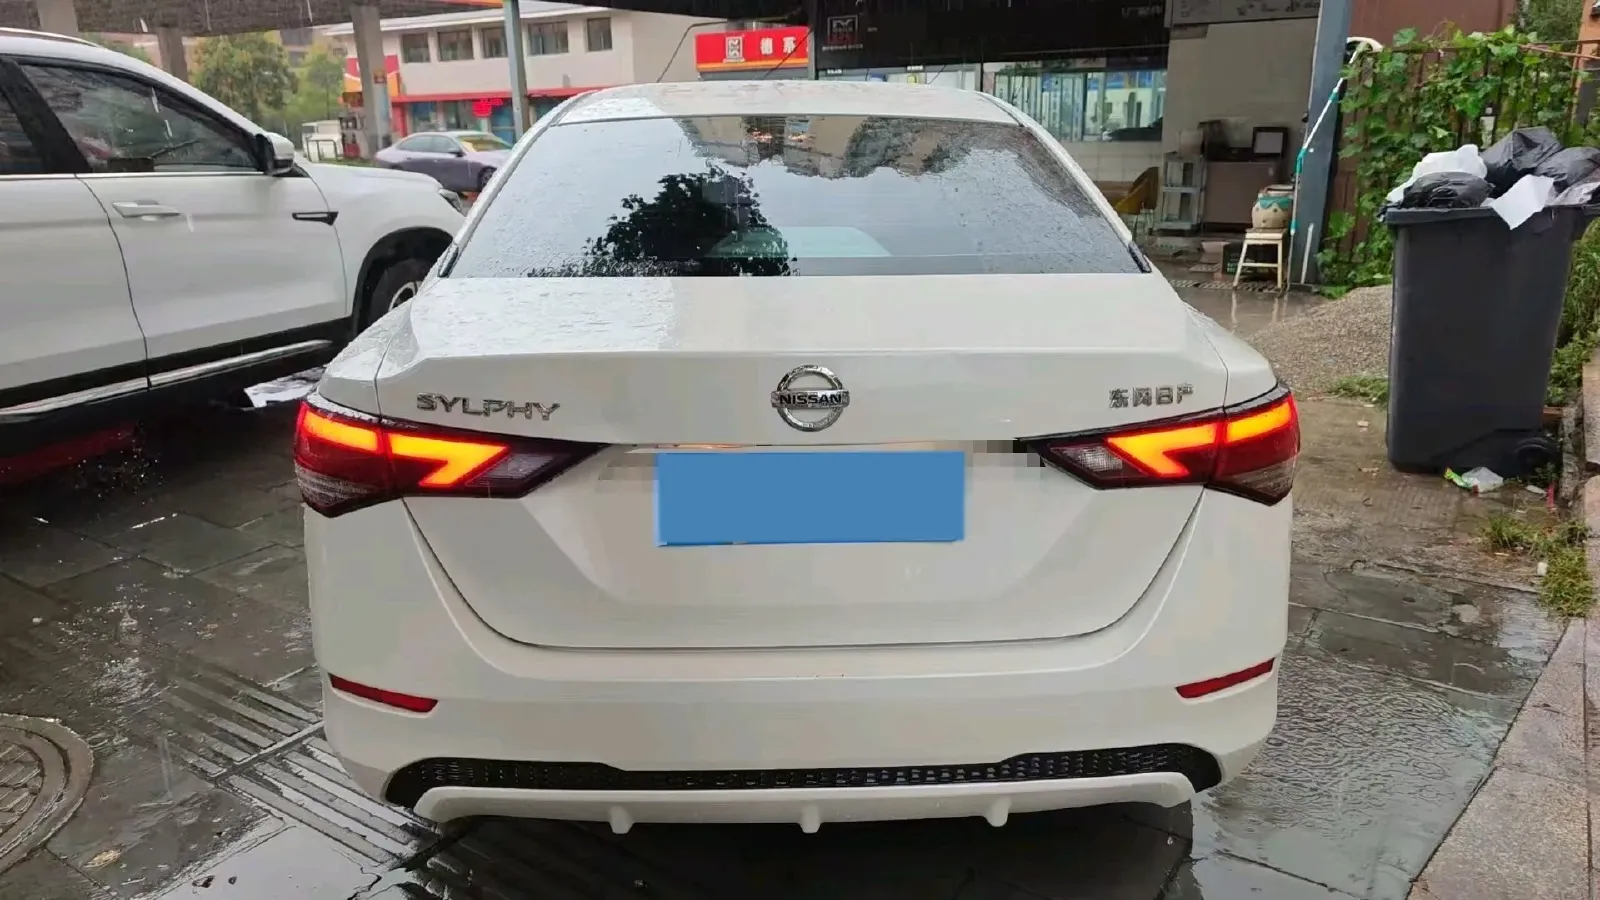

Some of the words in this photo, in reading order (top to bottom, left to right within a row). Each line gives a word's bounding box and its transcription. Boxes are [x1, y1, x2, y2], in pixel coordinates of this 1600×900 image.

[416, 392, 560, 421] SYLPHY
[778, 393, 843, 406] NISSAN
[1109, 383, 1194, 408] 东风日产
